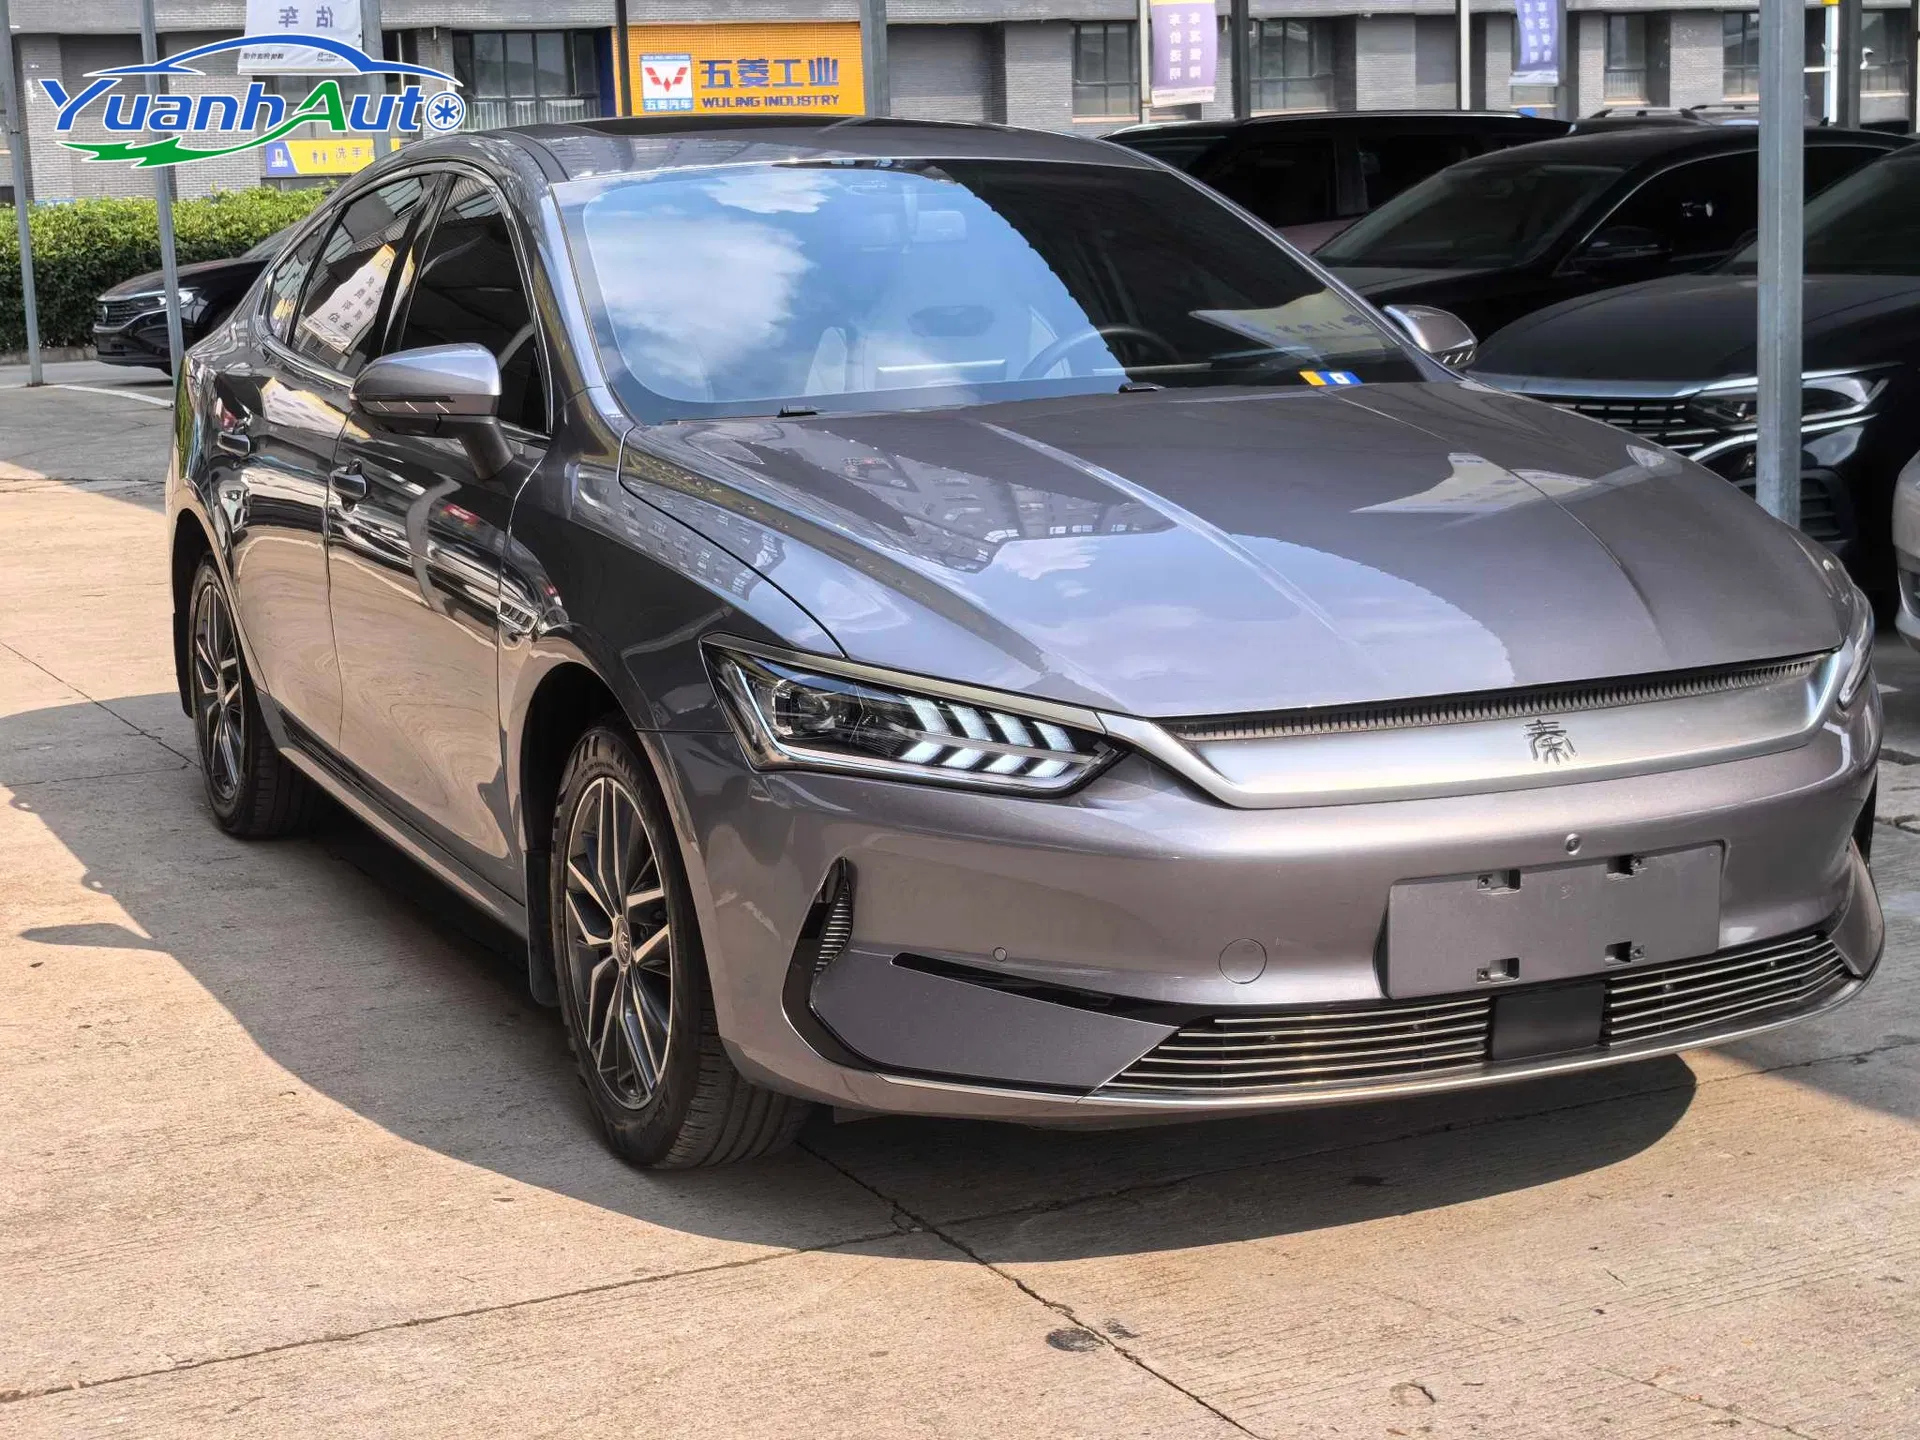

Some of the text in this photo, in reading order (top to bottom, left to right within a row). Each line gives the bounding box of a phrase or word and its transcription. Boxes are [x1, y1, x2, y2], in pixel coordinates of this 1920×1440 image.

[700, 57, 839, 89] 五菱工业
[644, 99, 692, 111] 五菱汽车
[702, 94, 839, 108] WULING INDUSTRY
[1524, 719, 1576, 765] 秦
